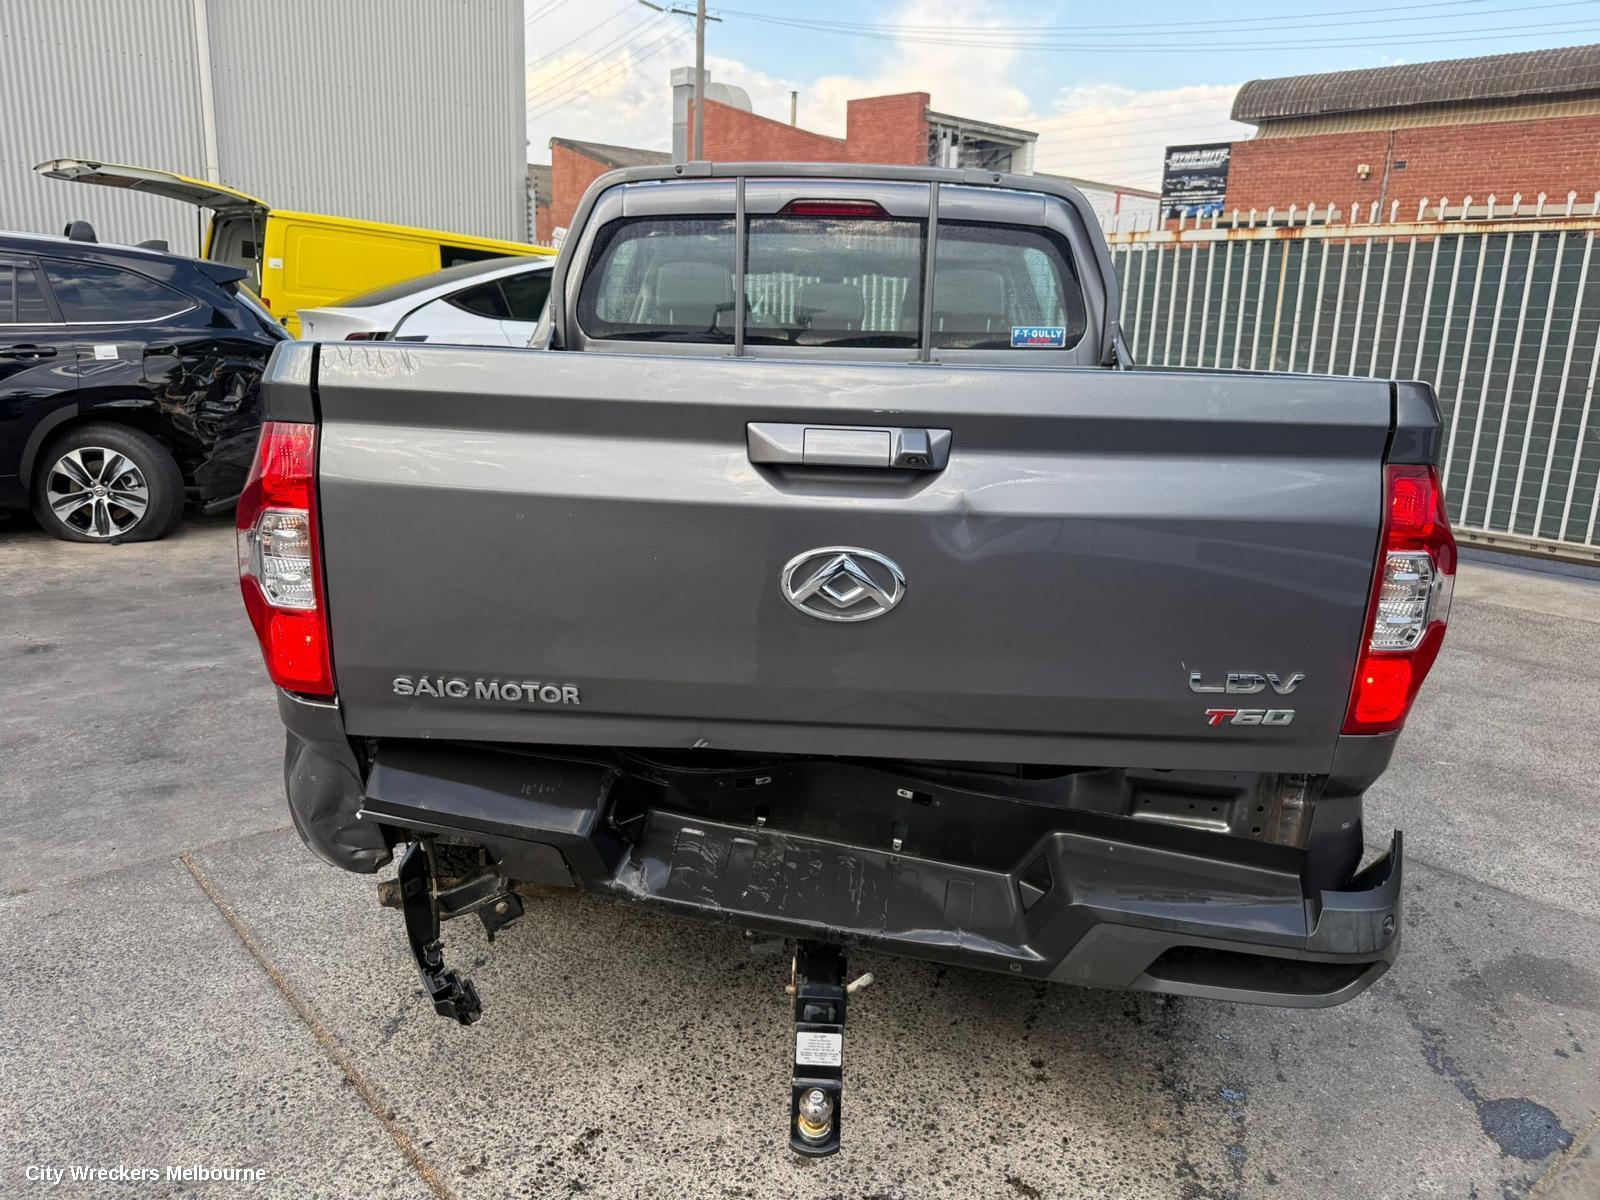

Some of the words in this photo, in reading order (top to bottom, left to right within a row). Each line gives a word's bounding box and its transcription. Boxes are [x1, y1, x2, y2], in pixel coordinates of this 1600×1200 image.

[393, 676, 469, 698] SAIC
[474, 679, 580, 704] MOTOR
[1189, 672, 1305, 694] LDV
[1205, 708, 1296, 726] T60
